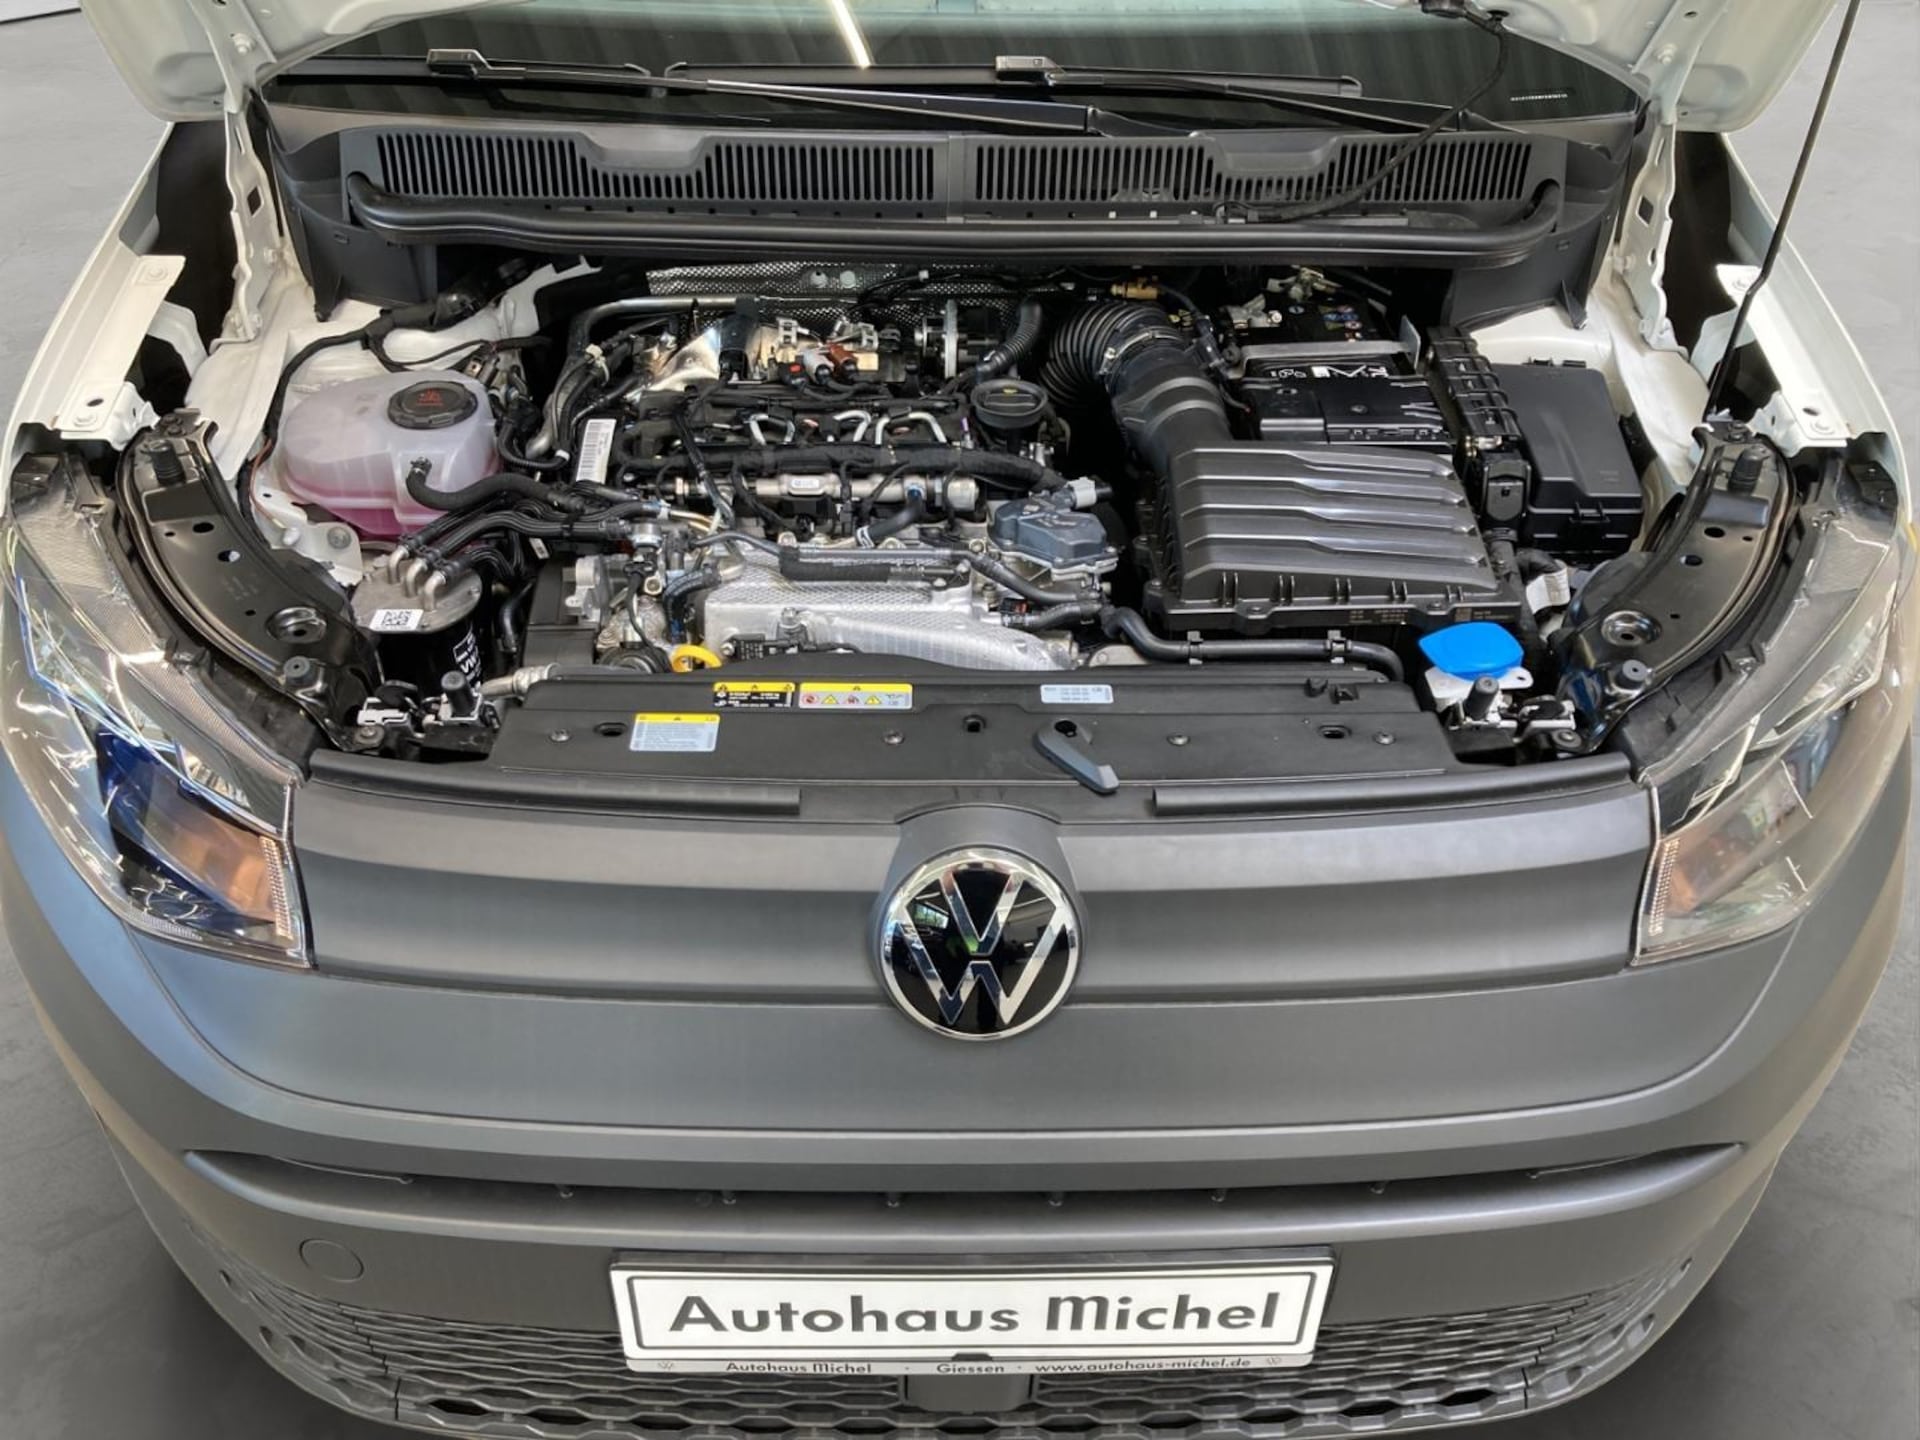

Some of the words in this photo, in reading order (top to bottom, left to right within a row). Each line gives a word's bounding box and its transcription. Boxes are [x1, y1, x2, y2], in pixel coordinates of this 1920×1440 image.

[889, 860, 1074, 1030] VW
[669, 1294, 1020, 1333] Autohaus
[1046, 1292, 1280, 1331] Michel
[725, 1361, 807, 1374] Autohaus
[813, 1361, 871, 1374] Michel
[936, 1362, 1004, 1374] Giessen
[1035, 1357, 1251, 1373] www.autohaus-michel.de
